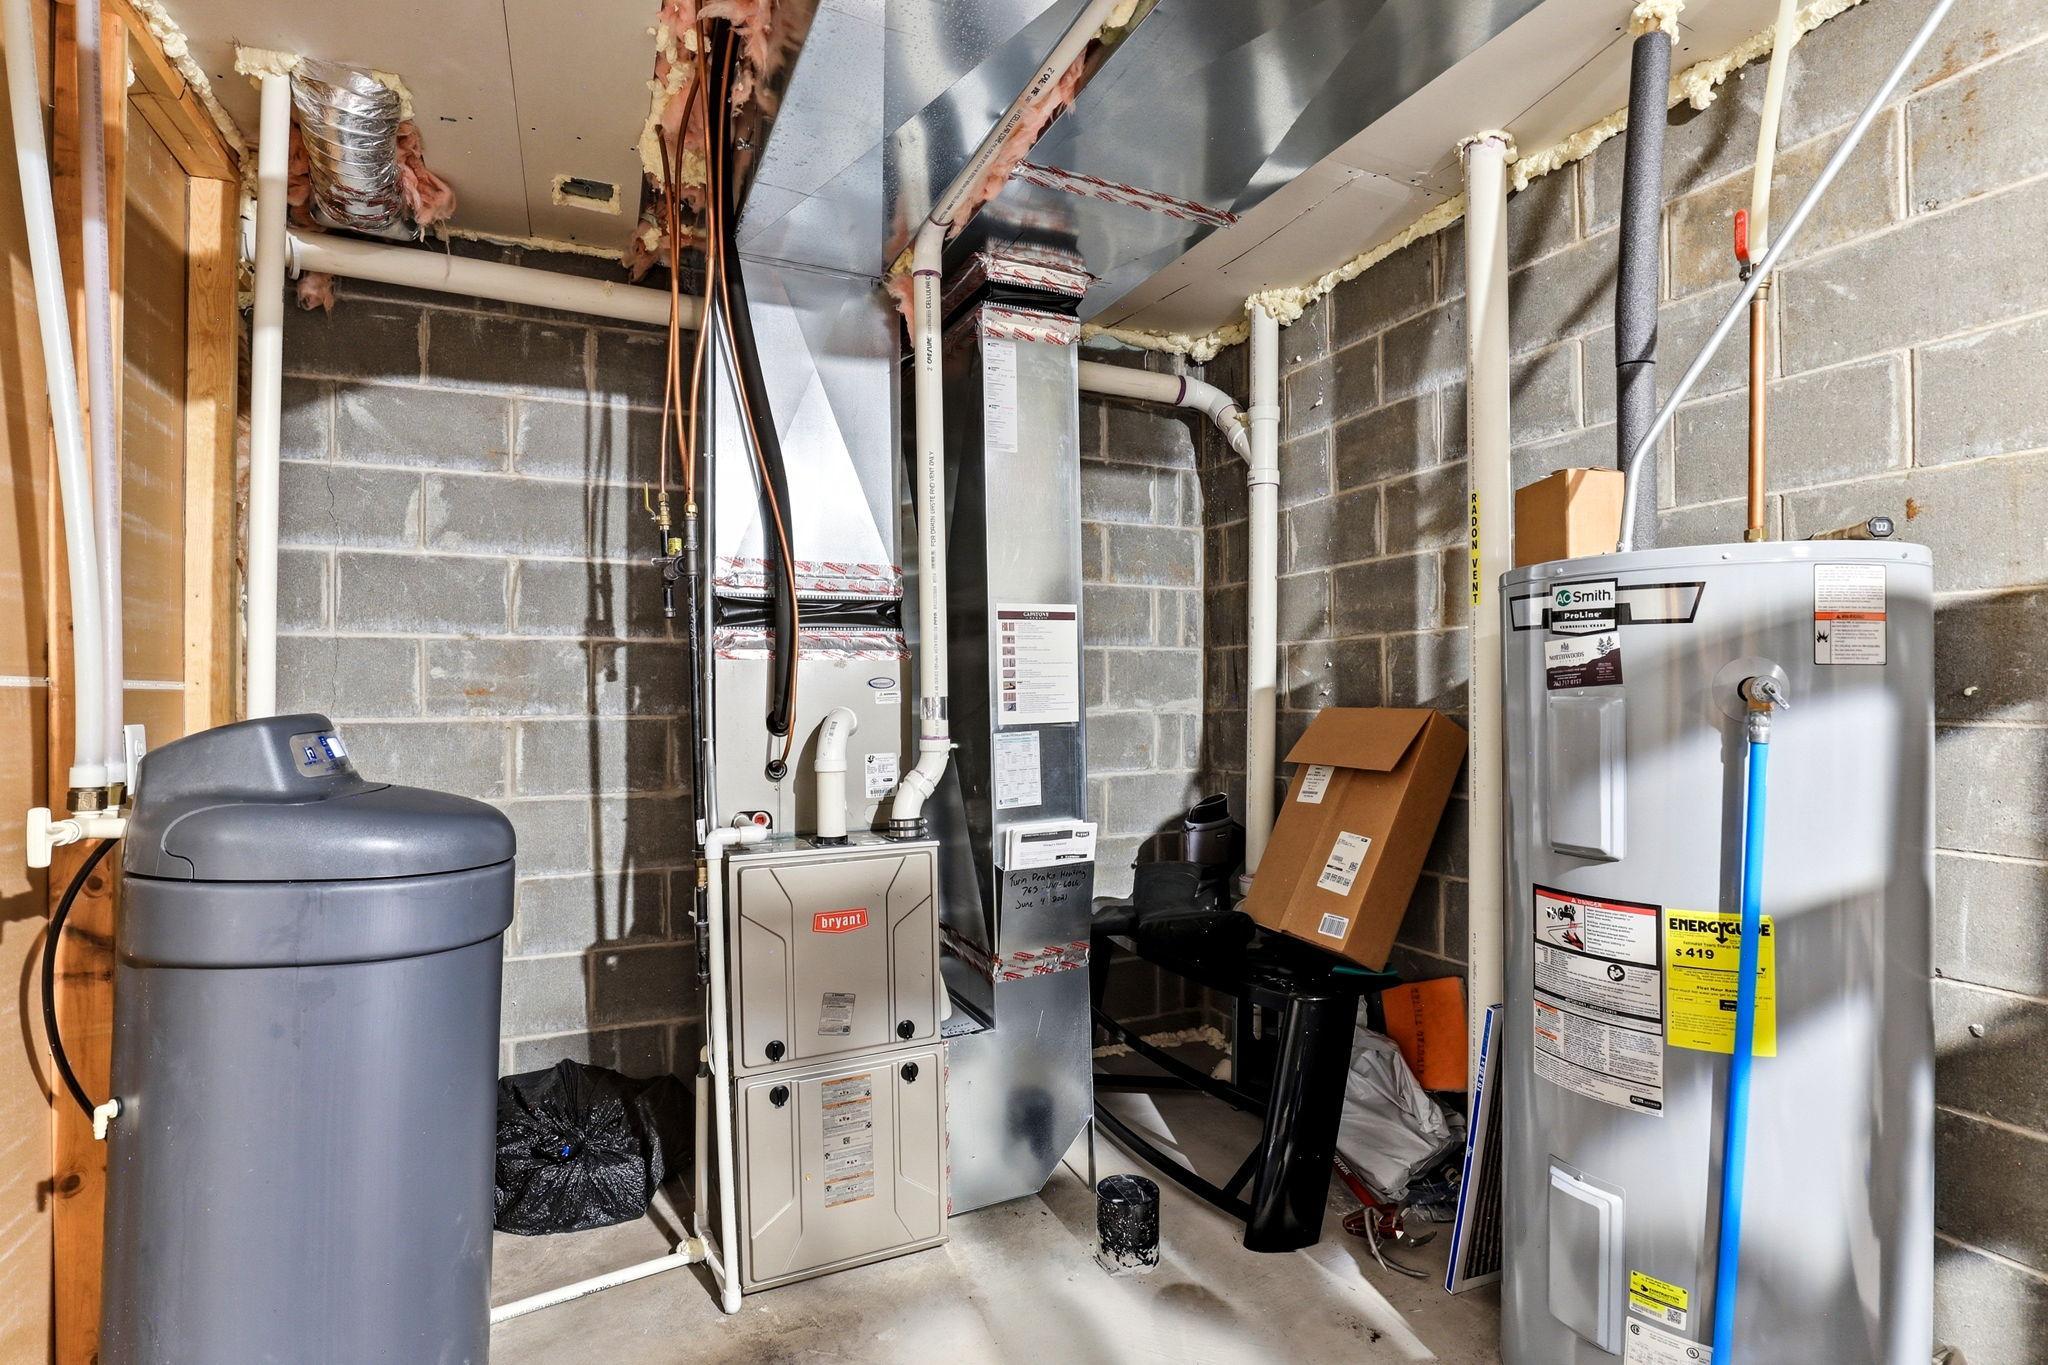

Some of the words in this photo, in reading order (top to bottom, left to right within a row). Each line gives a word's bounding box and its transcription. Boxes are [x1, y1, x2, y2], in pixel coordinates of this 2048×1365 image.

[1015, 900, 1034, 910] June
[821, 913, 862, 931] bryant
[1686, 948, 1715, 960] 419
